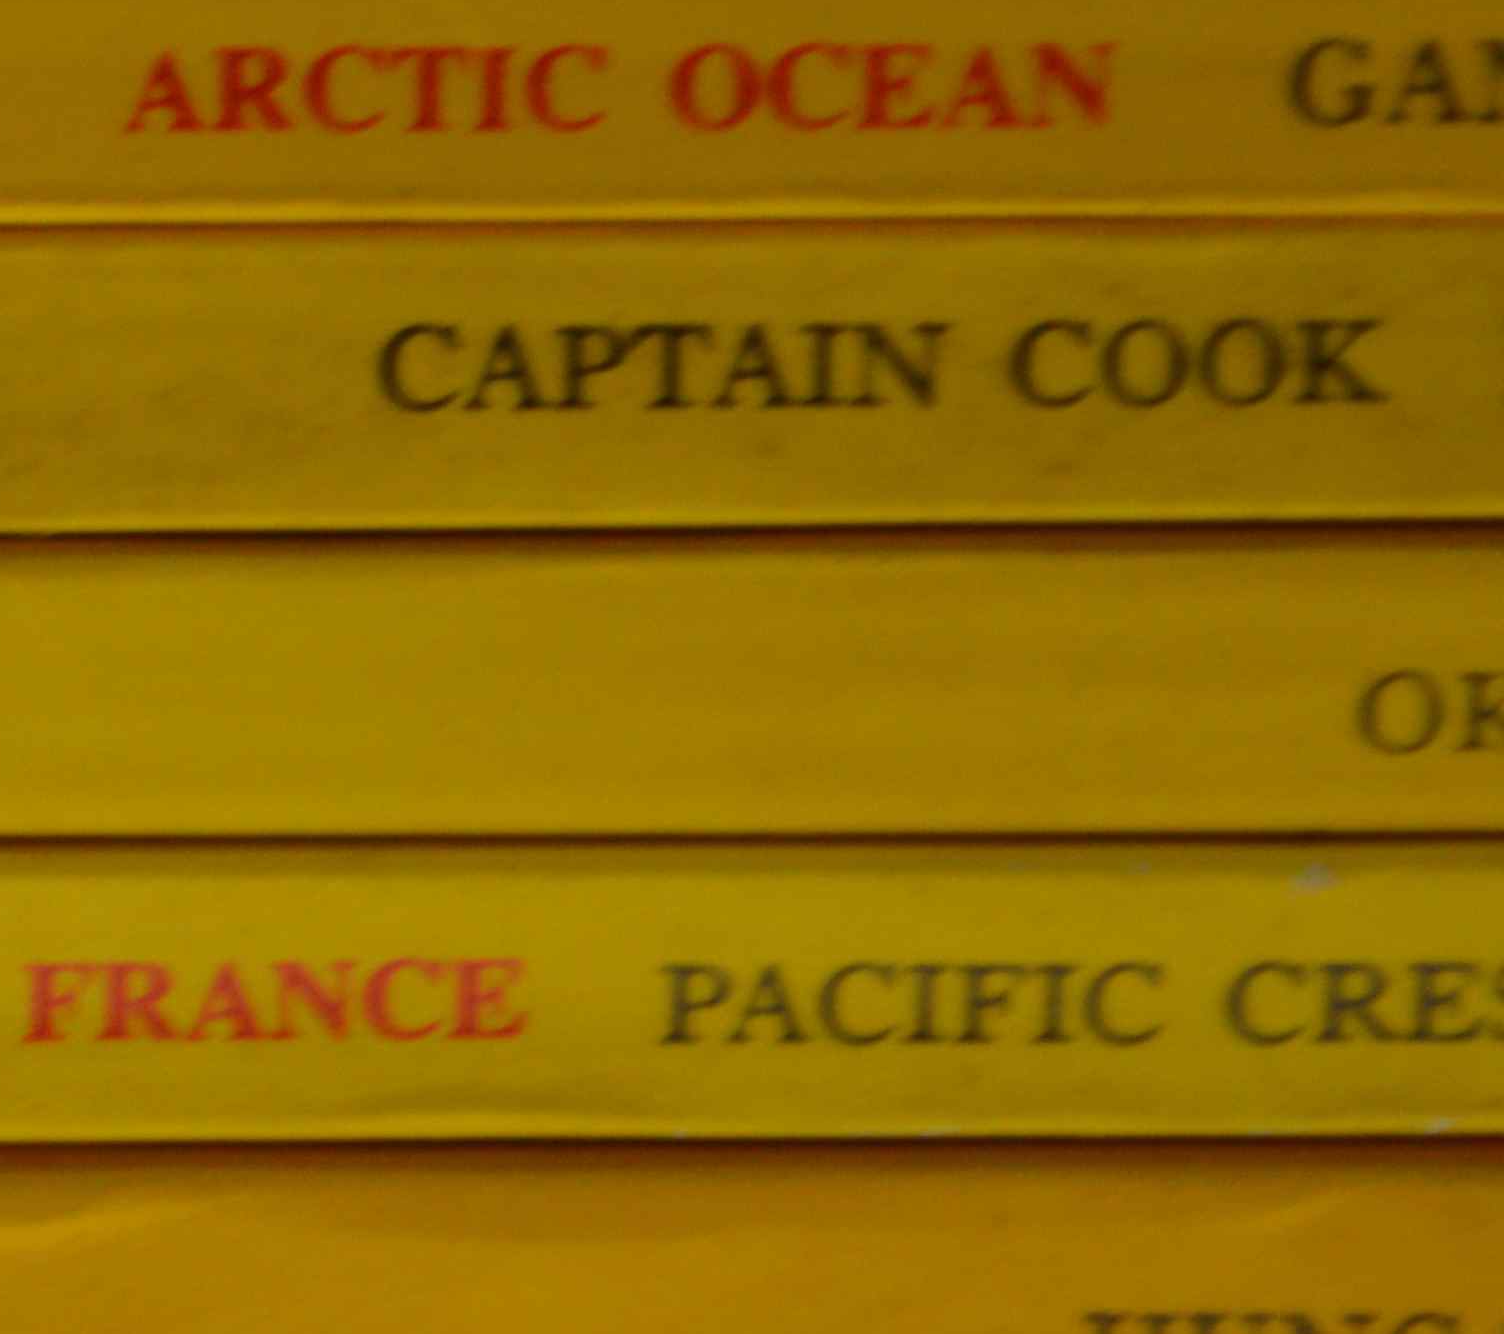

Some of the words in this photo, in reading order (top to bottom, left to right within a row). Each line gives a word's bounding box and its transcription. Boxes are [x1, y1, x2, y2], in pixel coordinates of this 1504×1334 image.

[124, 43, 608, 135] ARCTIC
[665, 42, 1114, 133] OCEAN
[375, 321, 951, 415] CAPTAIN
[1004, 317, 1387, 410] COOK
[21, 958, 528, 1045] FRANCE
[659, 962, 1161, 1048] PACIFIC
